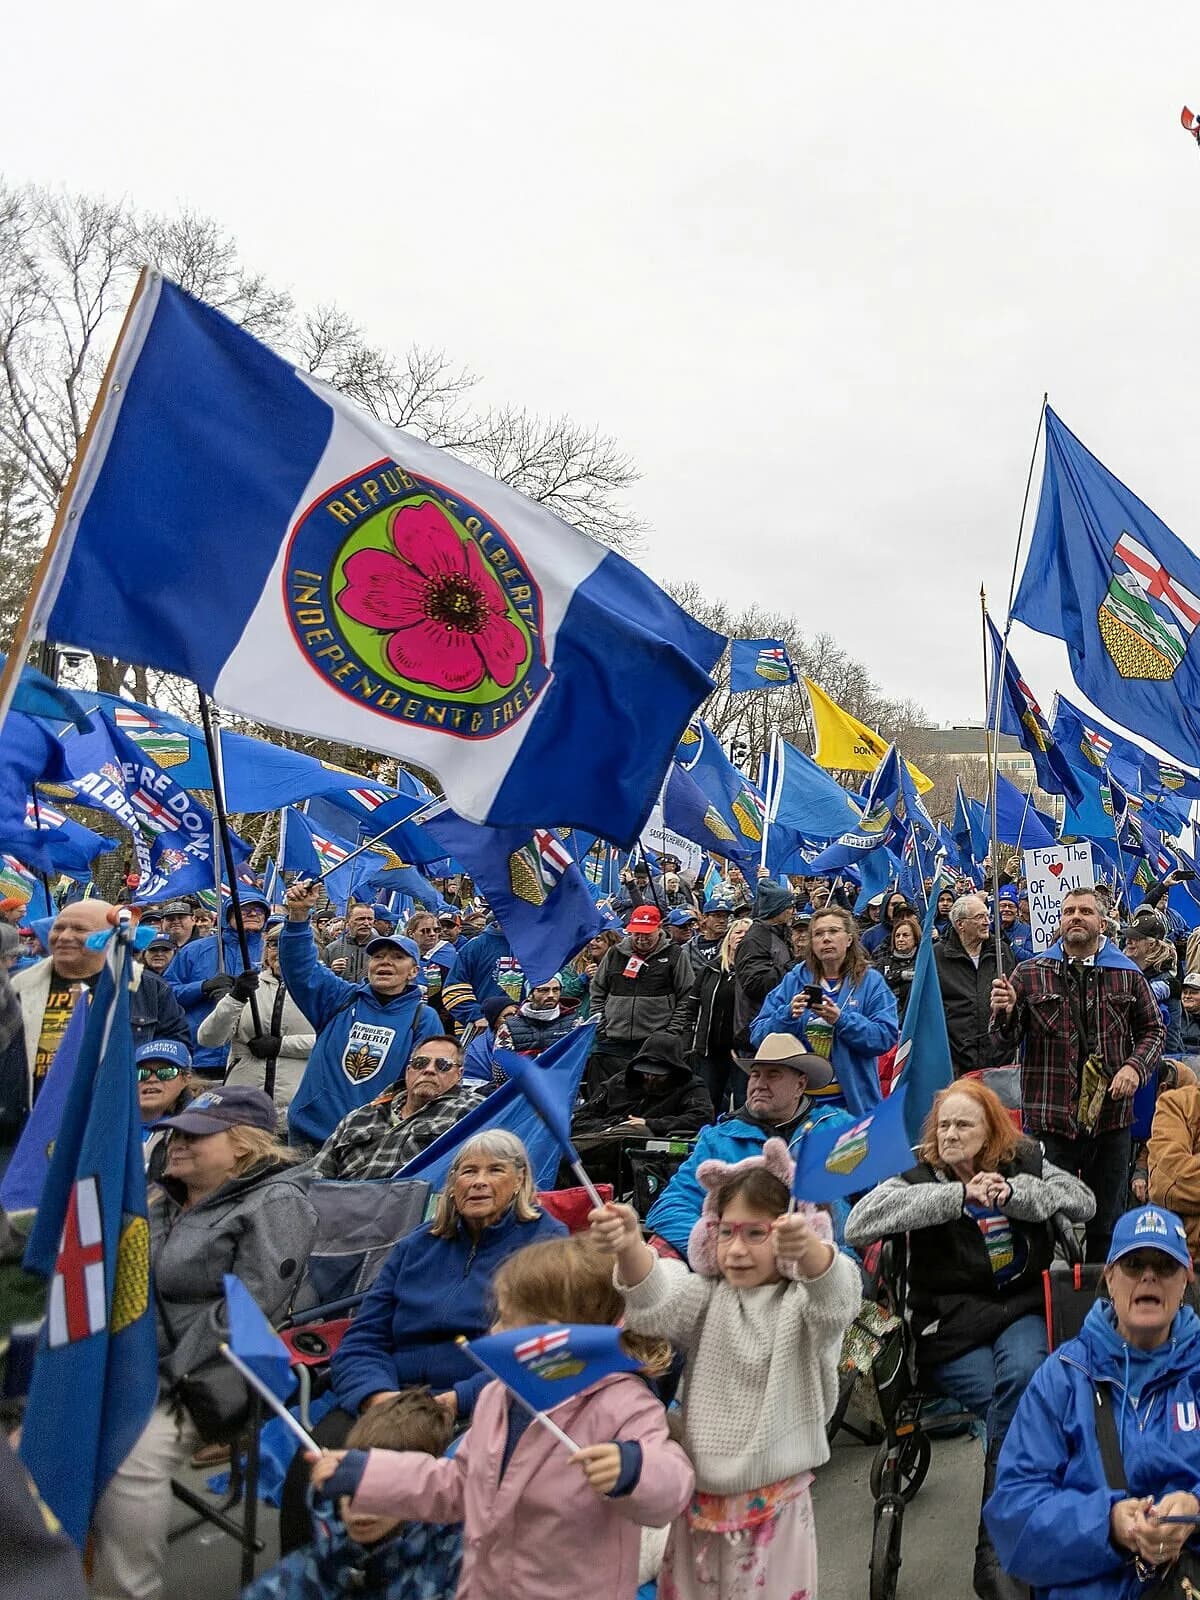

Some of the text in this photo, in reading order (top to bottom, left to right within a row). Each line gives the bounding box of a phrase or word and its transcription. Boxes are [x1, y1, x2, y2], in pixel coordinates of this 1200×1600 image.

[326, 465, 420, 525] REPUB
[293, 569, 538, 733] INDEPENDENT & FREE
[117, 758, 210, 862] E'RE DONE
[1033, 845, 1087, 866] For The
[1030, 875, 1081, 894] Of All
[1033, 895, 1060, 911] Albe
[1038, 910, 1060, 925] Vot
[1035, 926, 1055, 949] Opt
[350, 1030, 390, 1046] ALBERTA
[353, 1024, 384, 1036] REPUBLIC
